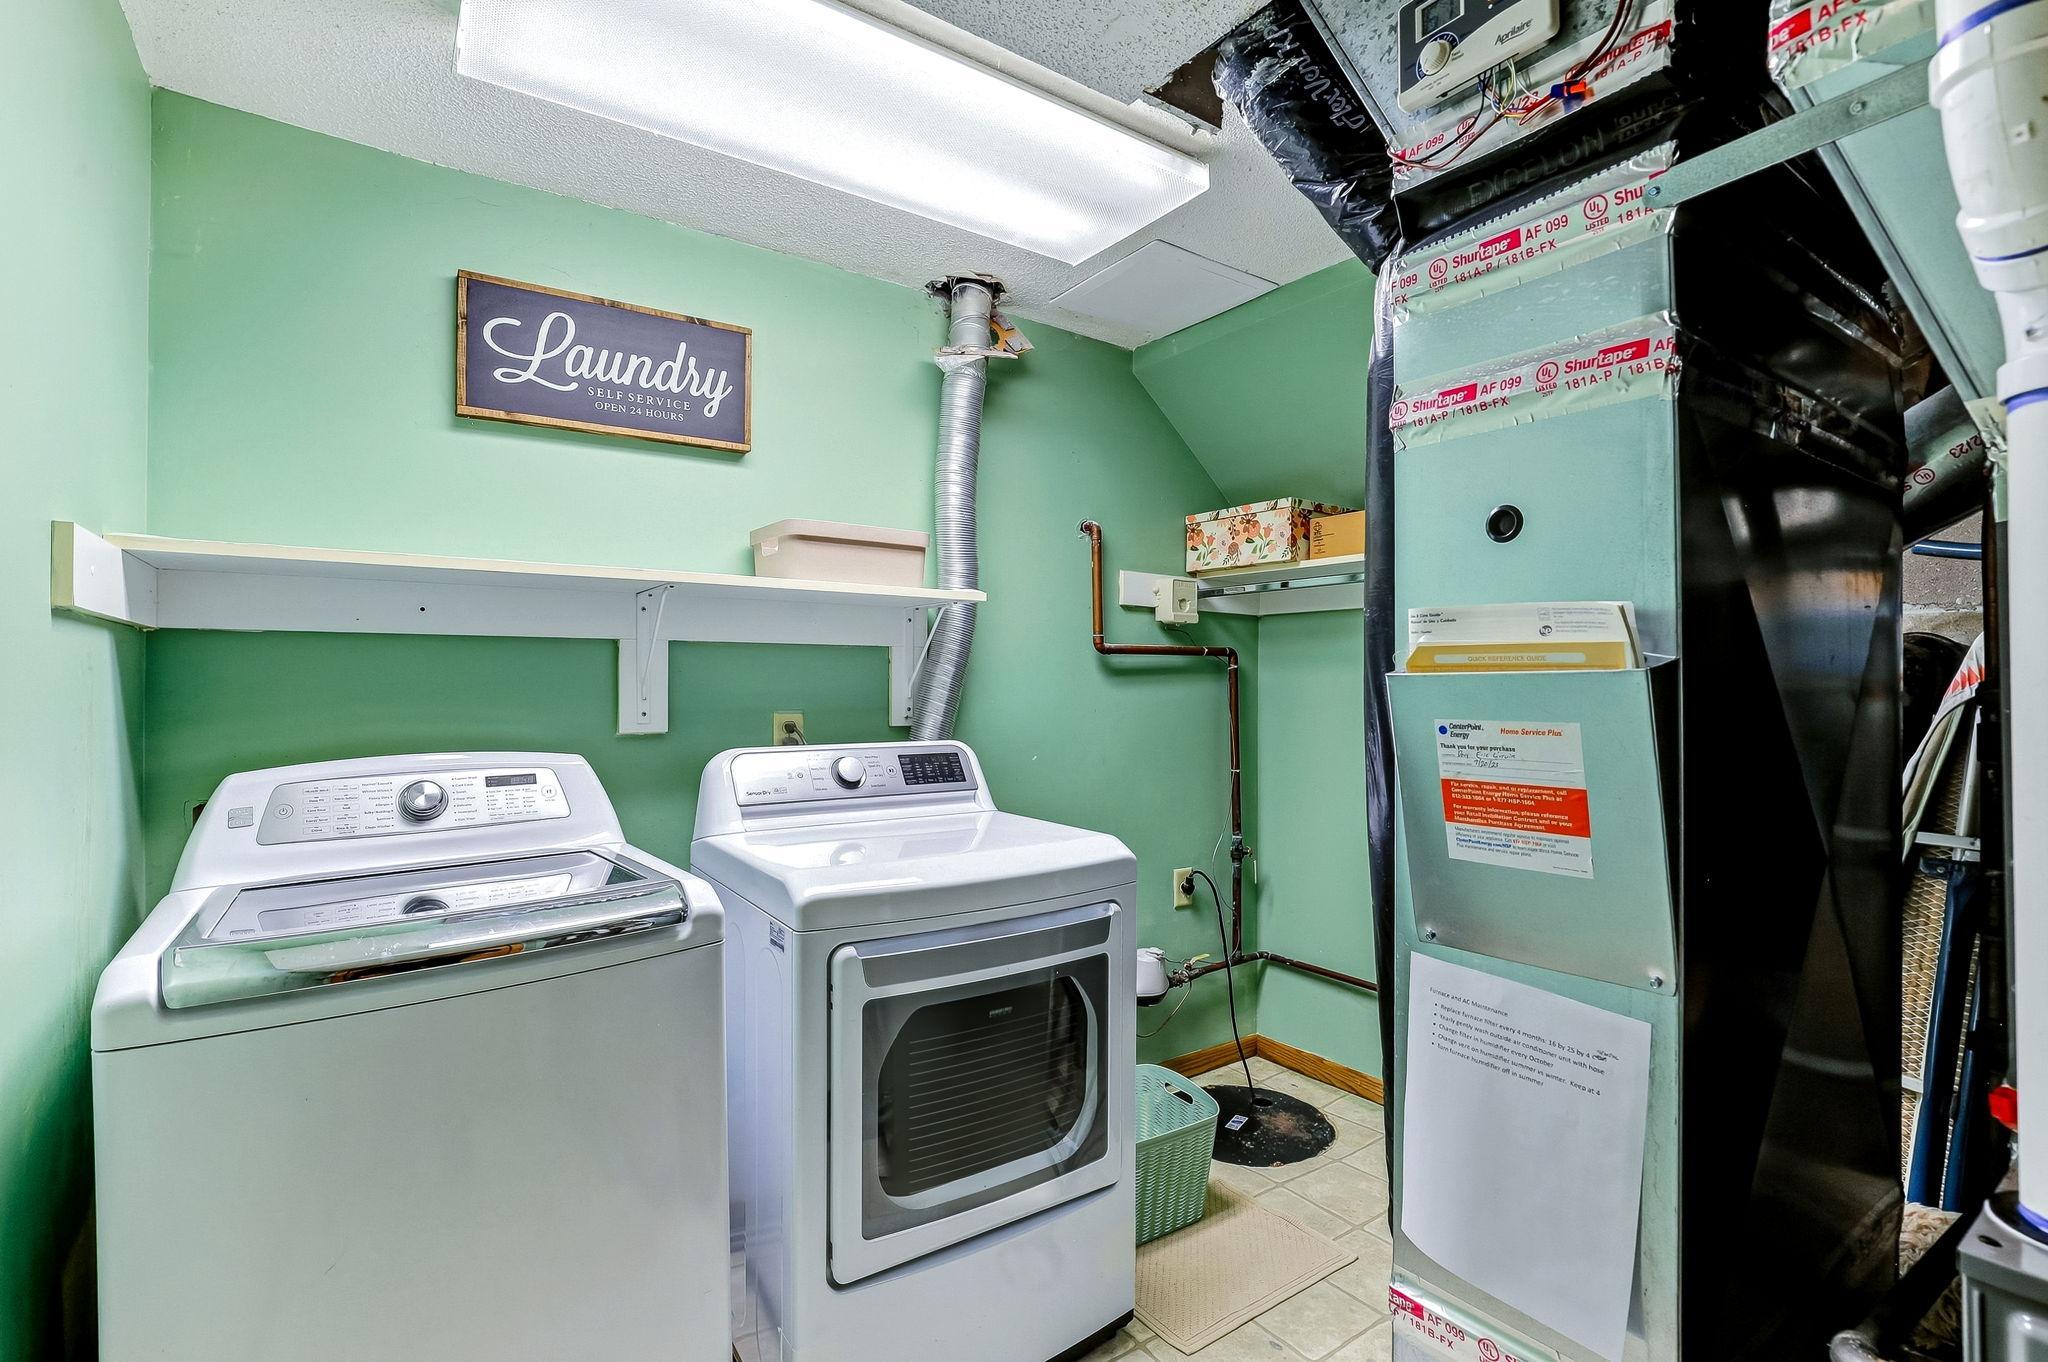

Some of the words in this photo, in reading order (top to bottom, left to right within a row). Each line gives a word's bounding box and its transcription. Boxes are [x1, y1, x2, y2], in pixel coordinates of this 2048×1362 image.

[1495, 18, 1532, 46] Aprilaire
[1408, 143, 1424, 159] AF
[1425, 134, 1445, 151] 099
[1614, 184, 1646, 206] Shu
[1525, 224, 1542, 242] AF
[1545, 214, 1568, 233] 099
[1585, 216, 1610, 231] LISTED
[1452, 239, 1510, 269] Shurtape
[1454, 262, 1492, 284] 181A-P
[1505, 238, 1557, 266] 181B-FX
[1400, 273, 1418, 289] 099
[1429, 277, 1448, 288] LISTED
[482, 311, 733, 418] Laundry
[1564, 348, 1634, 374] Shurtape
[1412, 390, 1465, 413] Shurtape
[1480, 382, 1497, 397] AF
[1500, 375, 1522, 391] 099
[1535, 381, 1558, 393] LISTED
[1565, 370, 1613, 391] 181A-P
[587, 386, 623, 401] SELF
[627, 392, 692, 411] SERVICE
[595, 401, 626, 413] OPEN
[630, 404, 642, 416] 24
[645, 408, 685, 422] HOURS
[1412, 410, 1449, 428] 181A-P
[1459, 395, 1510, 416] 181B-FX
[1450, 731, 1470, 739] Energy
[1520, 728, 1546, 736] Service
[1547, 729, 1562, 737] Plus
[1429, 986, 1450, 998] Furnace
[1451, 994, 1461, 1002] and
[1471, 1001, 1509, 1017] Maintenance
[1440, 1004, 1461, 1016] Replace
[1461, 1011, 1483, 1022] furnace
[1484, 1018, 1499, 1028] filter
[1499, 1024, 1516, 1034] every
[1549, 1039, 1557, 1047] 16
[1557, 1042, 1566, 1051] by
[1567, 1045, 1575, 1054] 25
[1576, 1049, 1585, 1057] by
[1456, 1020, 1473, 1030] gently
[1475, 1026, 1489, 1036] wash
[1490, 1031, 1512, 1043] outside
[1522, 1042, 1557, 1058] conditioner
[1558, 1055, 1571, 1064] unit
[1573, 1060, 1587, 1069] with
[1439, 1023, 1458, 1035] Change
[1459, 1030, 1473, 1040] filter
[1480, 1038, 1510, 1053] humidifier
[1511, 1049, 1528, 1060] every
[1529, 1055, 1554, 1068] October
[1438, 1033, 1457, 1045] Change
[1480, 1049, 1510, 1064] humidifier
[1511, 1060, 1536, 1073] summer
[1570, 1080, 1586, 1092] Keep
[1587, 1087, 1595, 1095] at
[1449, 1048, 1470, 1060] furnace
[1471, 1056, 1501, 1070] humidifier
[1501, 1067, 1511, 1075] off
[1518, 1073, 1544, 1086] summer
[1410, 1317, 1454, 1350] 181B-FX
[1427, 1313, 1442, 1327] AF
[1445, 1322, 1465, 1341] 099
